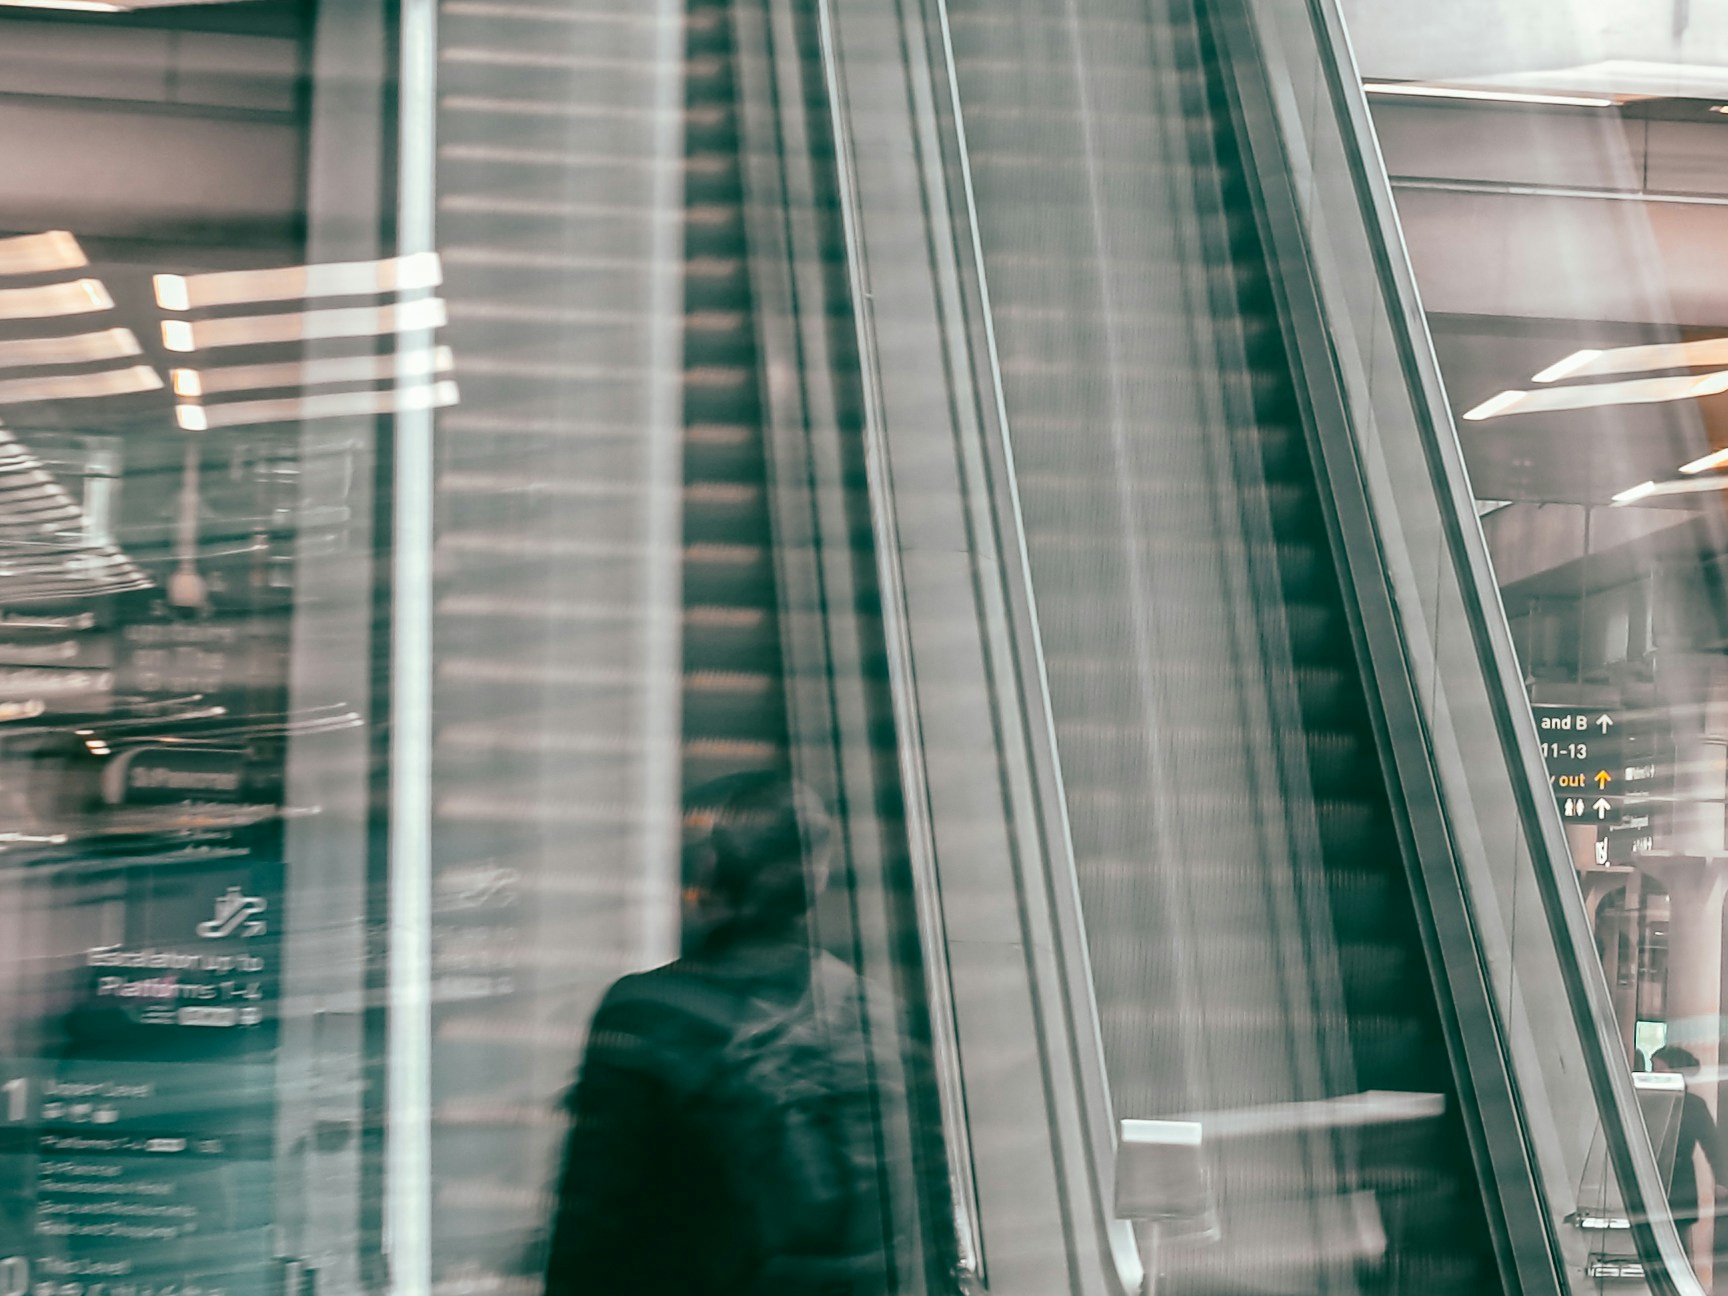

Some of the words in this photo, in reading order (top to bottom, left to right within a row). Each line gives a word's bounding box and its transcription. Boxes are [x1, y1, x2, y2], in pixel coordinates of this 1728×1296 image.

[1541, 715, 1571, 730] and
[1575, 715, 1588, 730] B
[1559, 773, 1586, 787] out
